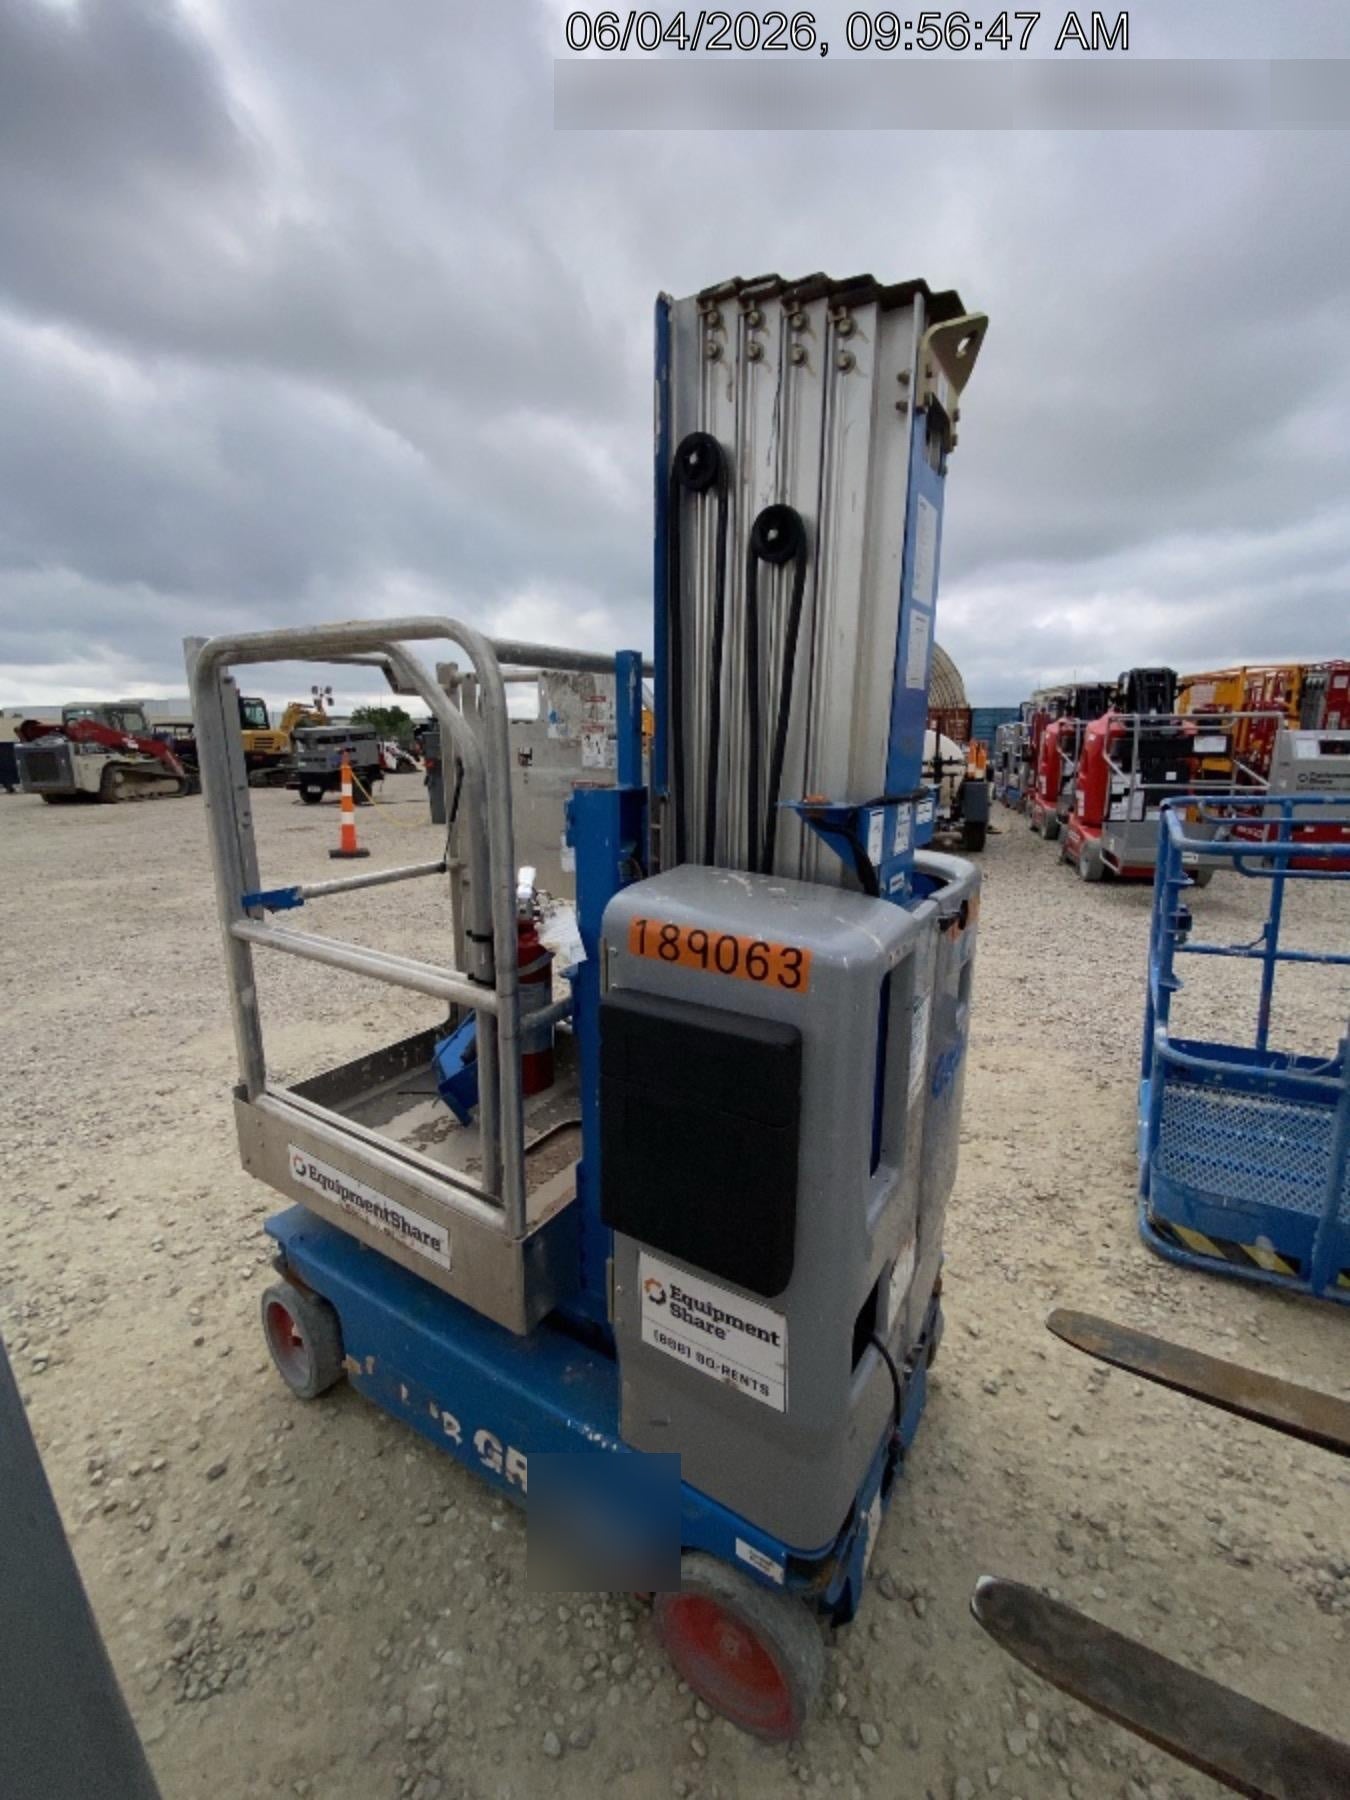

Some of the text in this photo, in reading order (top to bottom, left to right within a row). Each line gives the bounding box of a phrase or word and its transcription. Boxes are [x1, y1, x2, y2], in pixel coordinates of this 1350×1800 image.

[635, 919, 804, 989] 189063
[308, 1162, 441, 1251] EquipmentShare
[669, 1283, 781, 1348] Equipment
[669, 1301, 727, 1341] Share
